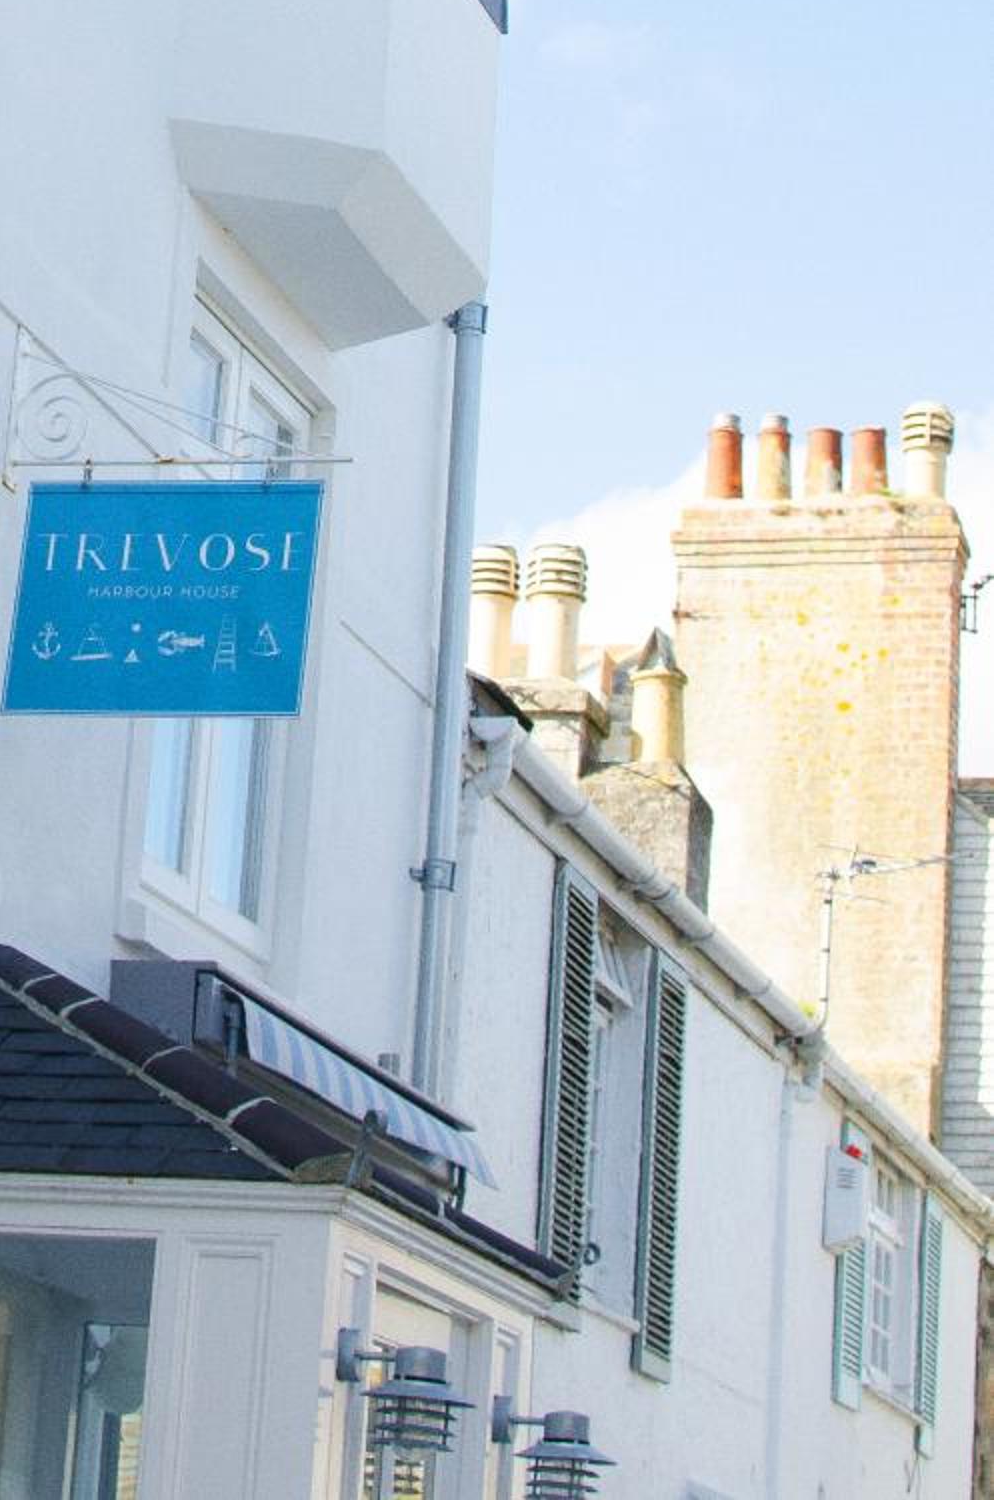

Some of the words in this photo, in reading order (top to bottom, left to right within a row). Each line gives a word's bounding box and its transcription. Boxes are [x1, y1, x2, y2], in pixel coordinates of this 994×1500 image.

[39, 532, 305, 572] TREVOSE
[88, 585, 173, 599] HARBOUR
[180, 585, 240, 599] HOUSE
